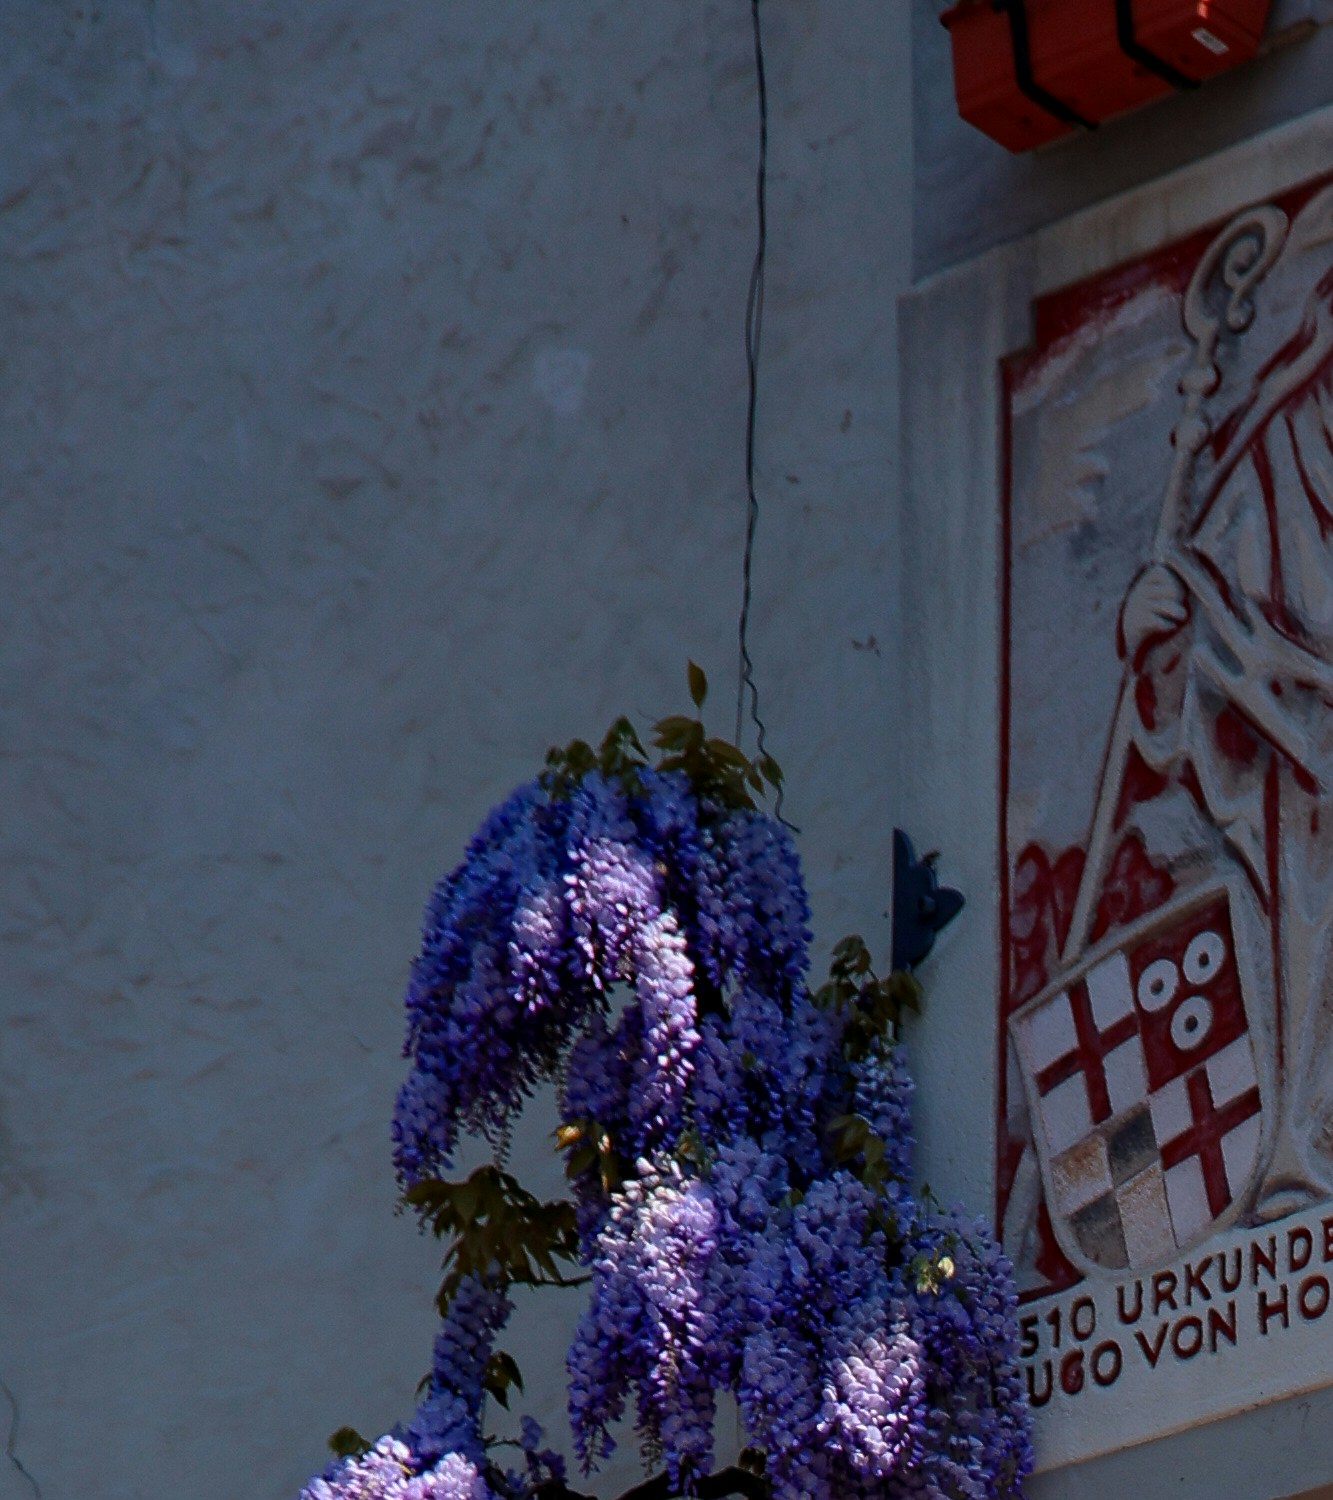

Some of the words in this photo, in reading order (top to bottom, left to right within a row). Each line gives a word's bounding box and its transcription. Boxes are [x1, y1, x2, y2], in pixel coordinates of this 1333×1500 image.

[1018, 1293, 1096, 1358] 510
[1022, 1338, 1123, 1408] UGO
[1141, 1298, 1239, 1371] VON
